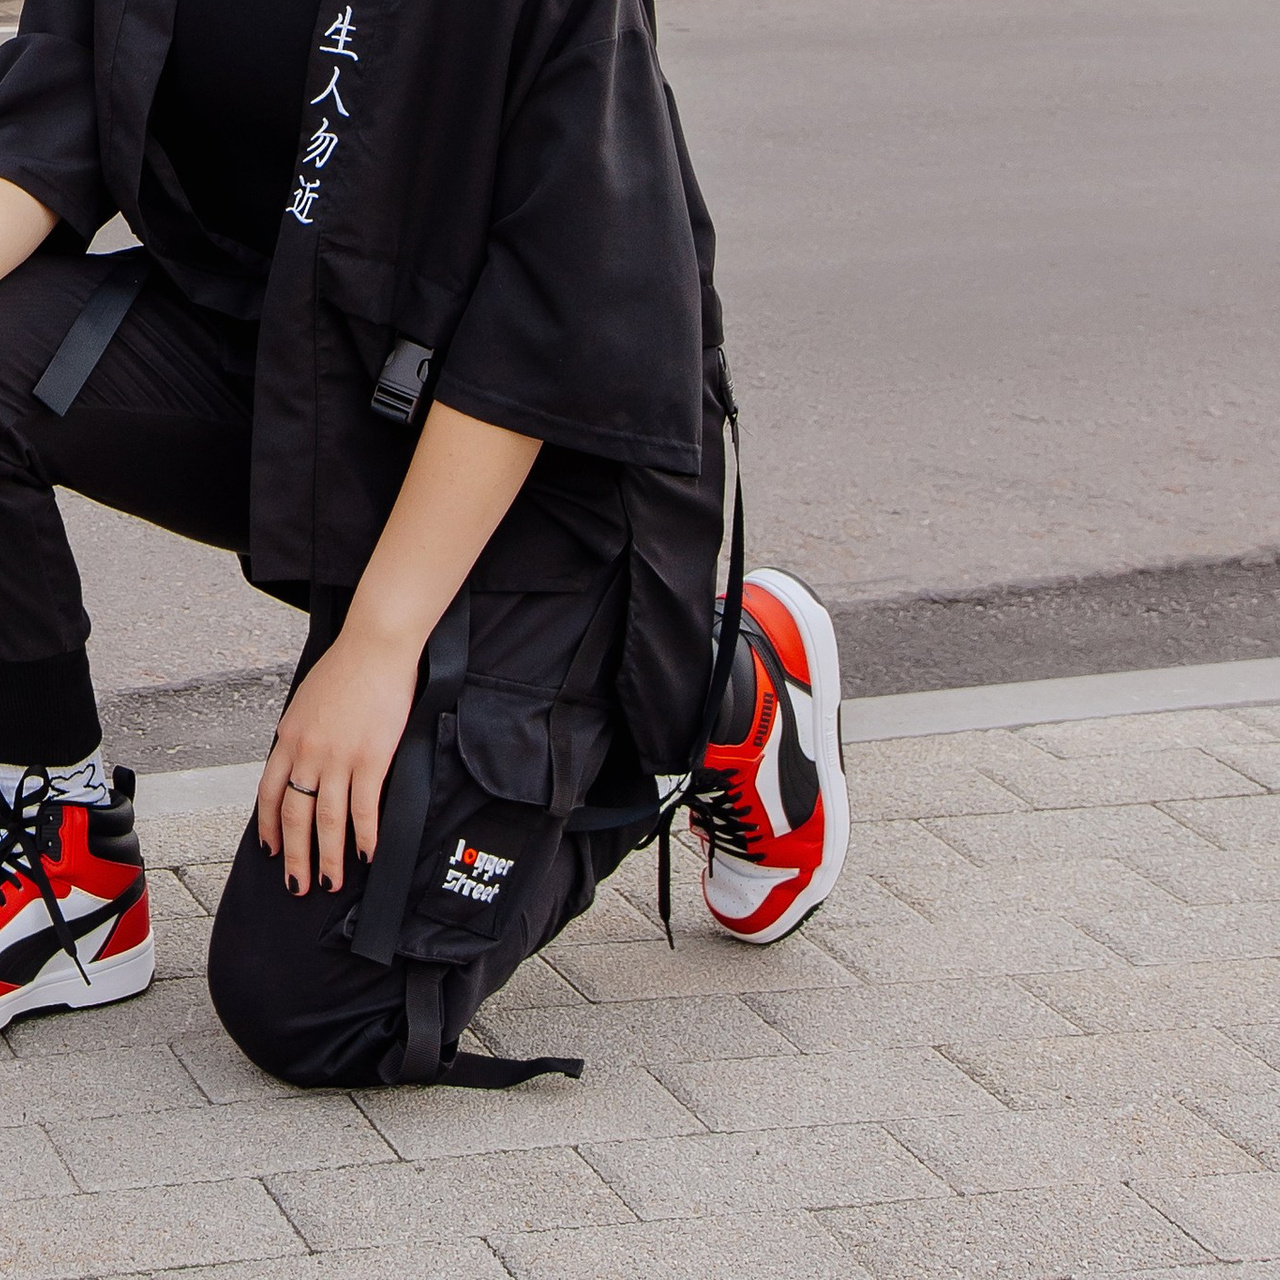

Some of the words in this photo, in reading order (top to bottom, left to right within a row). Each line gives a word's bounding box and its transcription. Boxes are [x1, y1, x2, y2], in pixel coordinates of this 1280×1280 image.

[285, 5, 359, 224] 生人勿近
[753, 691, 774, 748] PUMA
[449, 838, 515, 881] Jogger
[441, 868, 500, 904] Street
